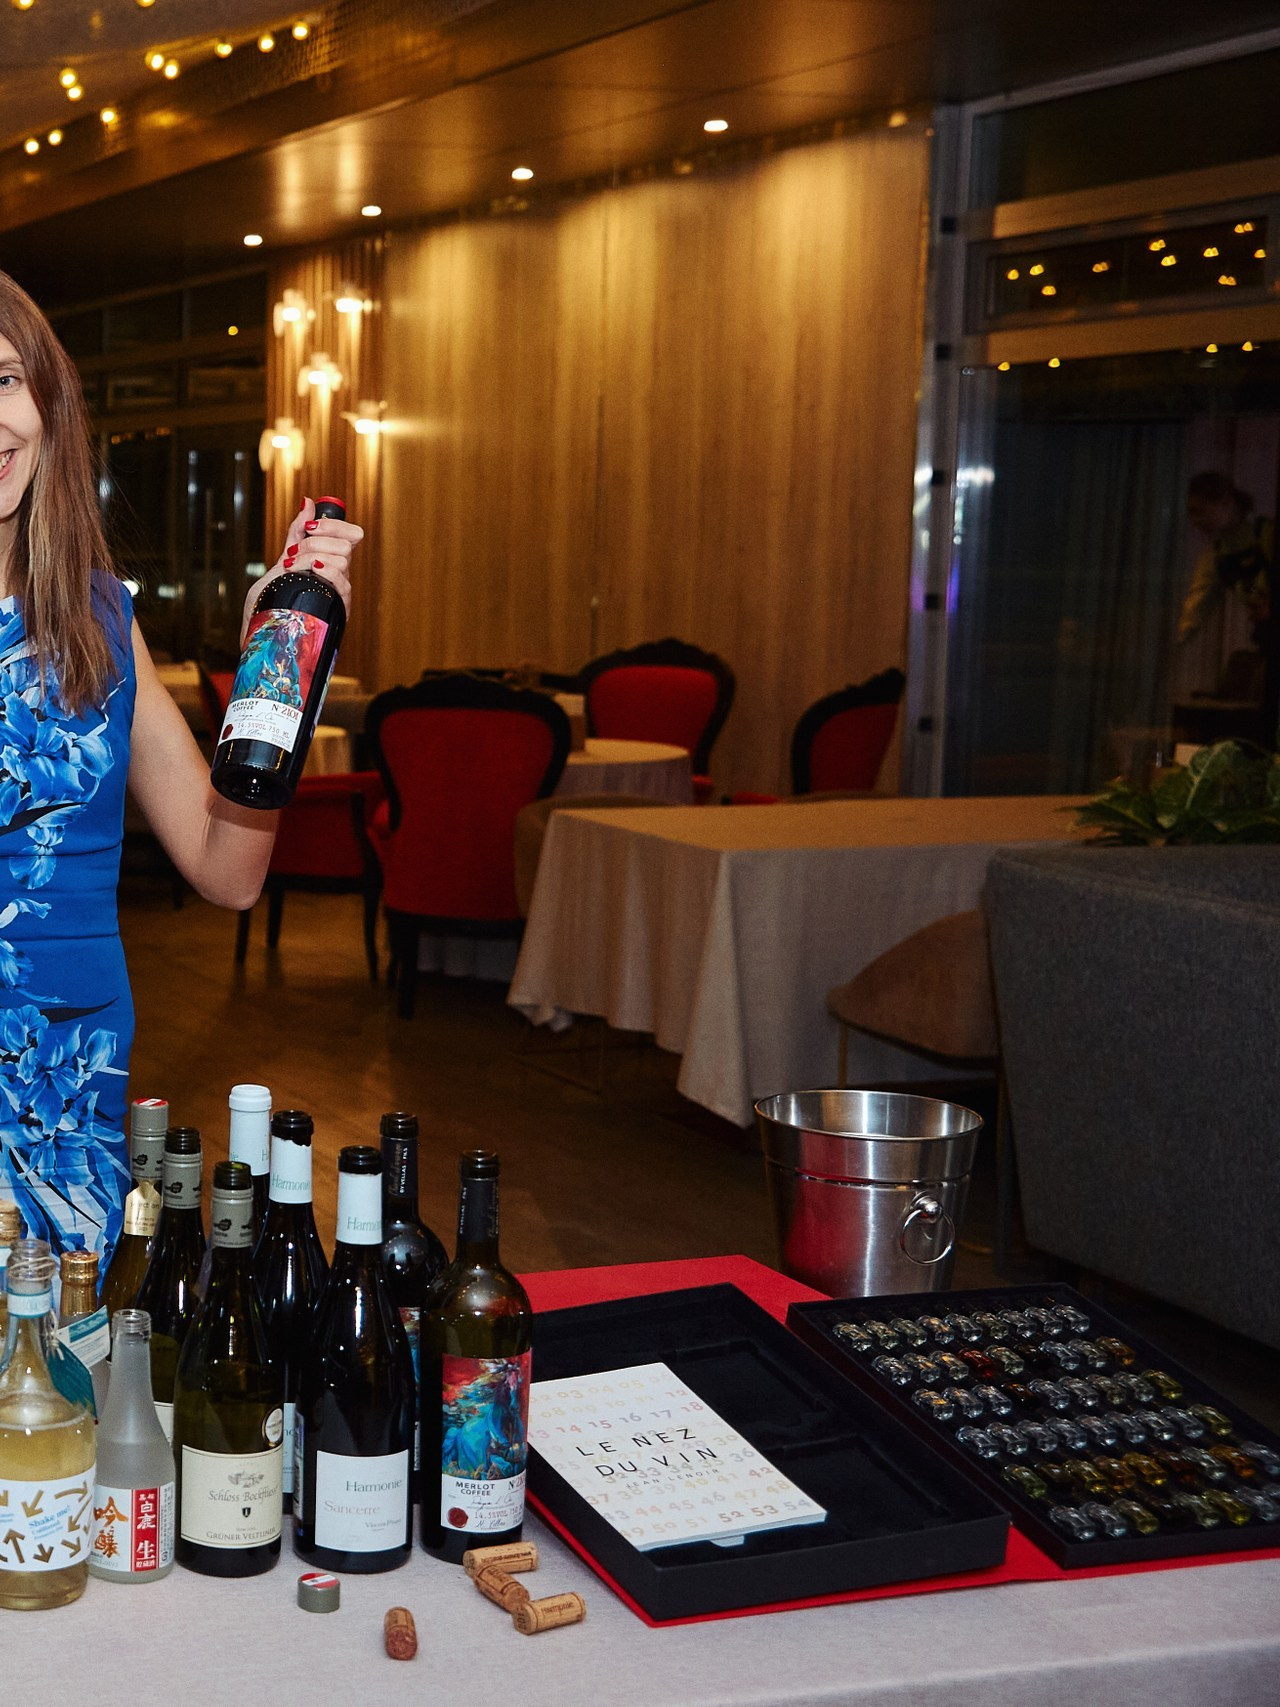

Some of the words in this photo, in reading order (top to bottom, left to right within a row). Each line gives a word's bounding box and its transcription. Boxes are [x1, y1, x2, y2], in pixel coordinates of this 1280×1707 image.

[232, 700, 259, 709] MERLOT
[556, 1424, 582, 1434] 14
[588, 1419, 613, 1429] 15
[619, 1412, 642, 1424] 16
[649, 1409, 673, 1419] 17
[680, 1401, 704, 1413] 18
[575, 1441, 617, 1457] LE
[632, 1428, 697, 1448] NEZ
[712, 1434, 738, 1447] 30
[595, 1460, 638, 1477] DU
[651, 1447, 718, 1467] VIN
[637, 1467, 662, 1479] 33
[670, 1463, 694, 1474] 34
[729, 1448, 755, 1462] 36
[345, 1479, 403, 1492] Harmonie
[455, 1481, 496, 1490] MERLOT
[586, 1493, 610, 1506] 37
[683, 1478, 709, 1490] 40
[748, 1466, 773, 1478] 42
[625, 1478, 661, 1489] JEAN
[667, 1469, 720, 1482] LENOIR
[208, 1489, 240, 1502] Schloss
[460, 1488, 491, 1496] COFFEE
[635, 1505, 662, 1516] 44
[670, 1500, 695, 1511] 45
[701, 1491, 726, 1507] 46
[766, 1480, 791, 1495] 48
[323, 1500, 381, 1515] Sancerre
[719, 1510, 745, 1523] 52
[750, 1504, 779, 1517] 53
[783, 1499, 812, 1511] 54
[29, 1514, 55, 1529] Shake
[206, 1530, 240, 1541] GRÜNER
